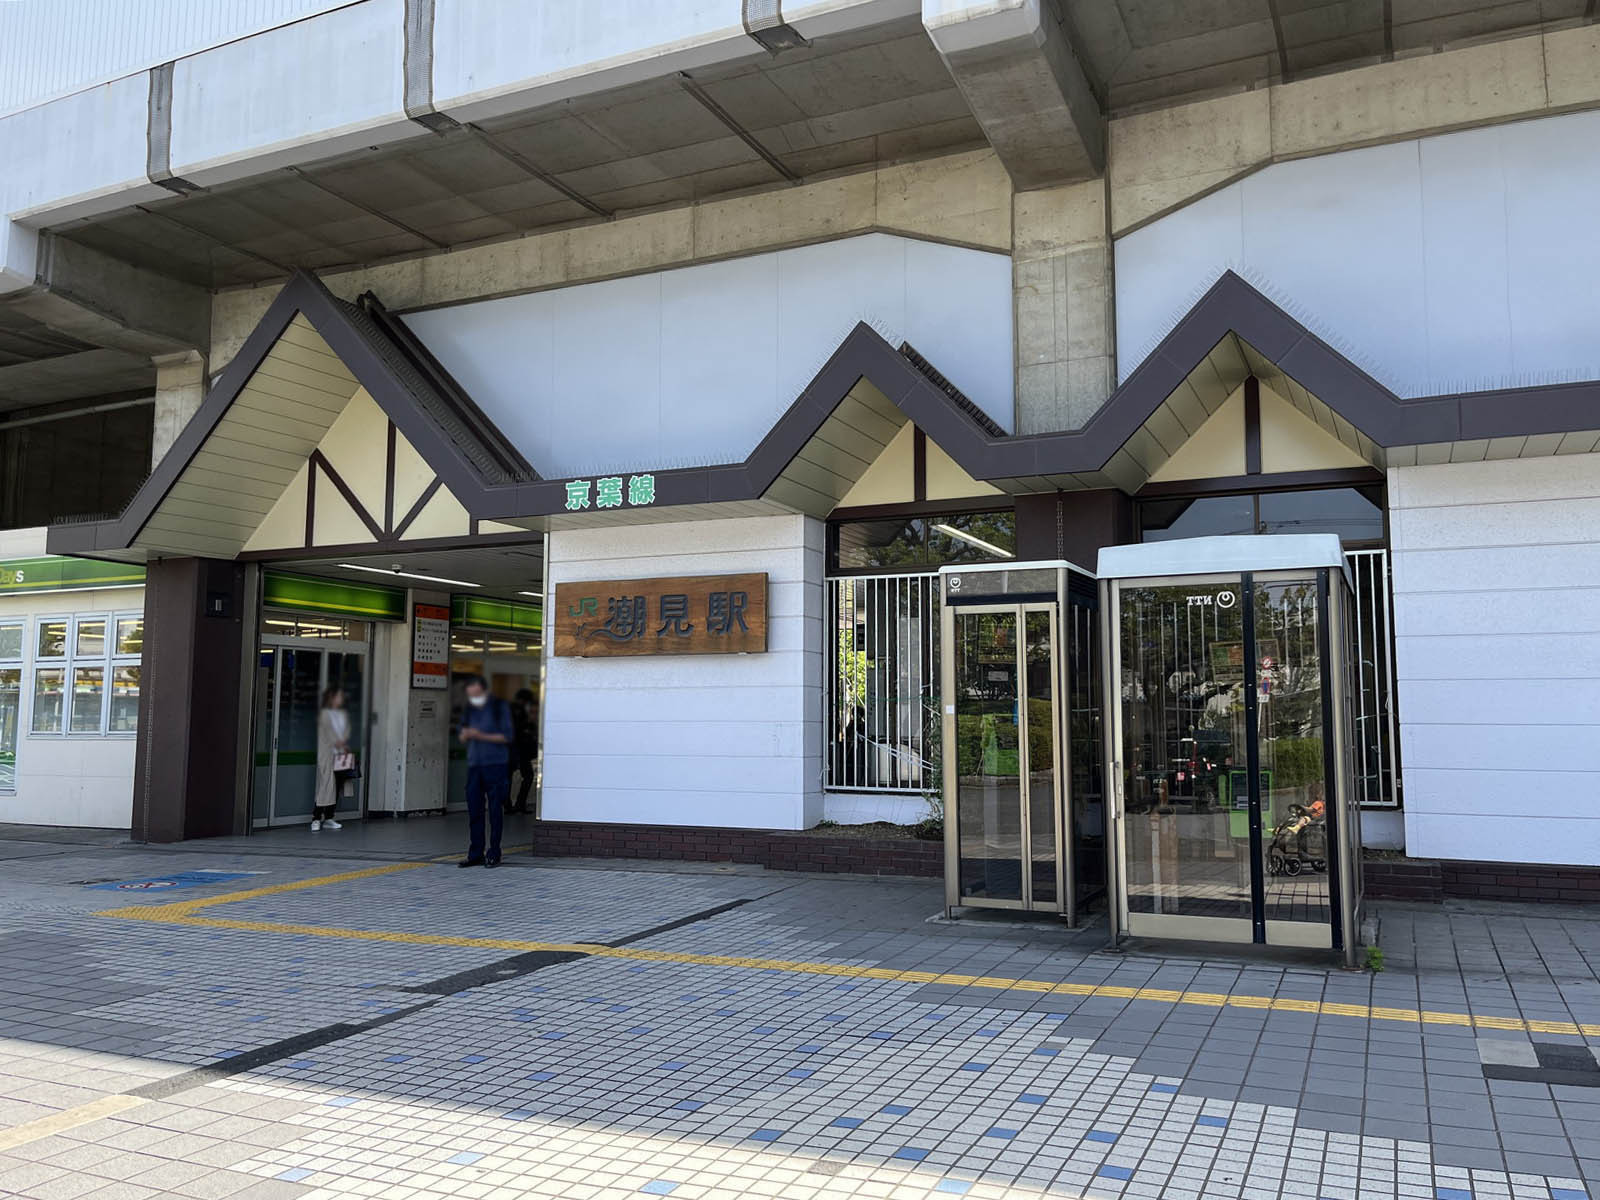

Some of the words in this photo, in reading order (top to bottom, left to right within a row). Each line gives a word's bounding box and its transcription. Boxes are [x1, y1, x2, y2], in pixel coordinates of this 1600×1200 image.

[565, 474, 656, 510] 京葉線
[568, 597, 599, 617] JR
[592, 591, 750, 642] 潮見駅
